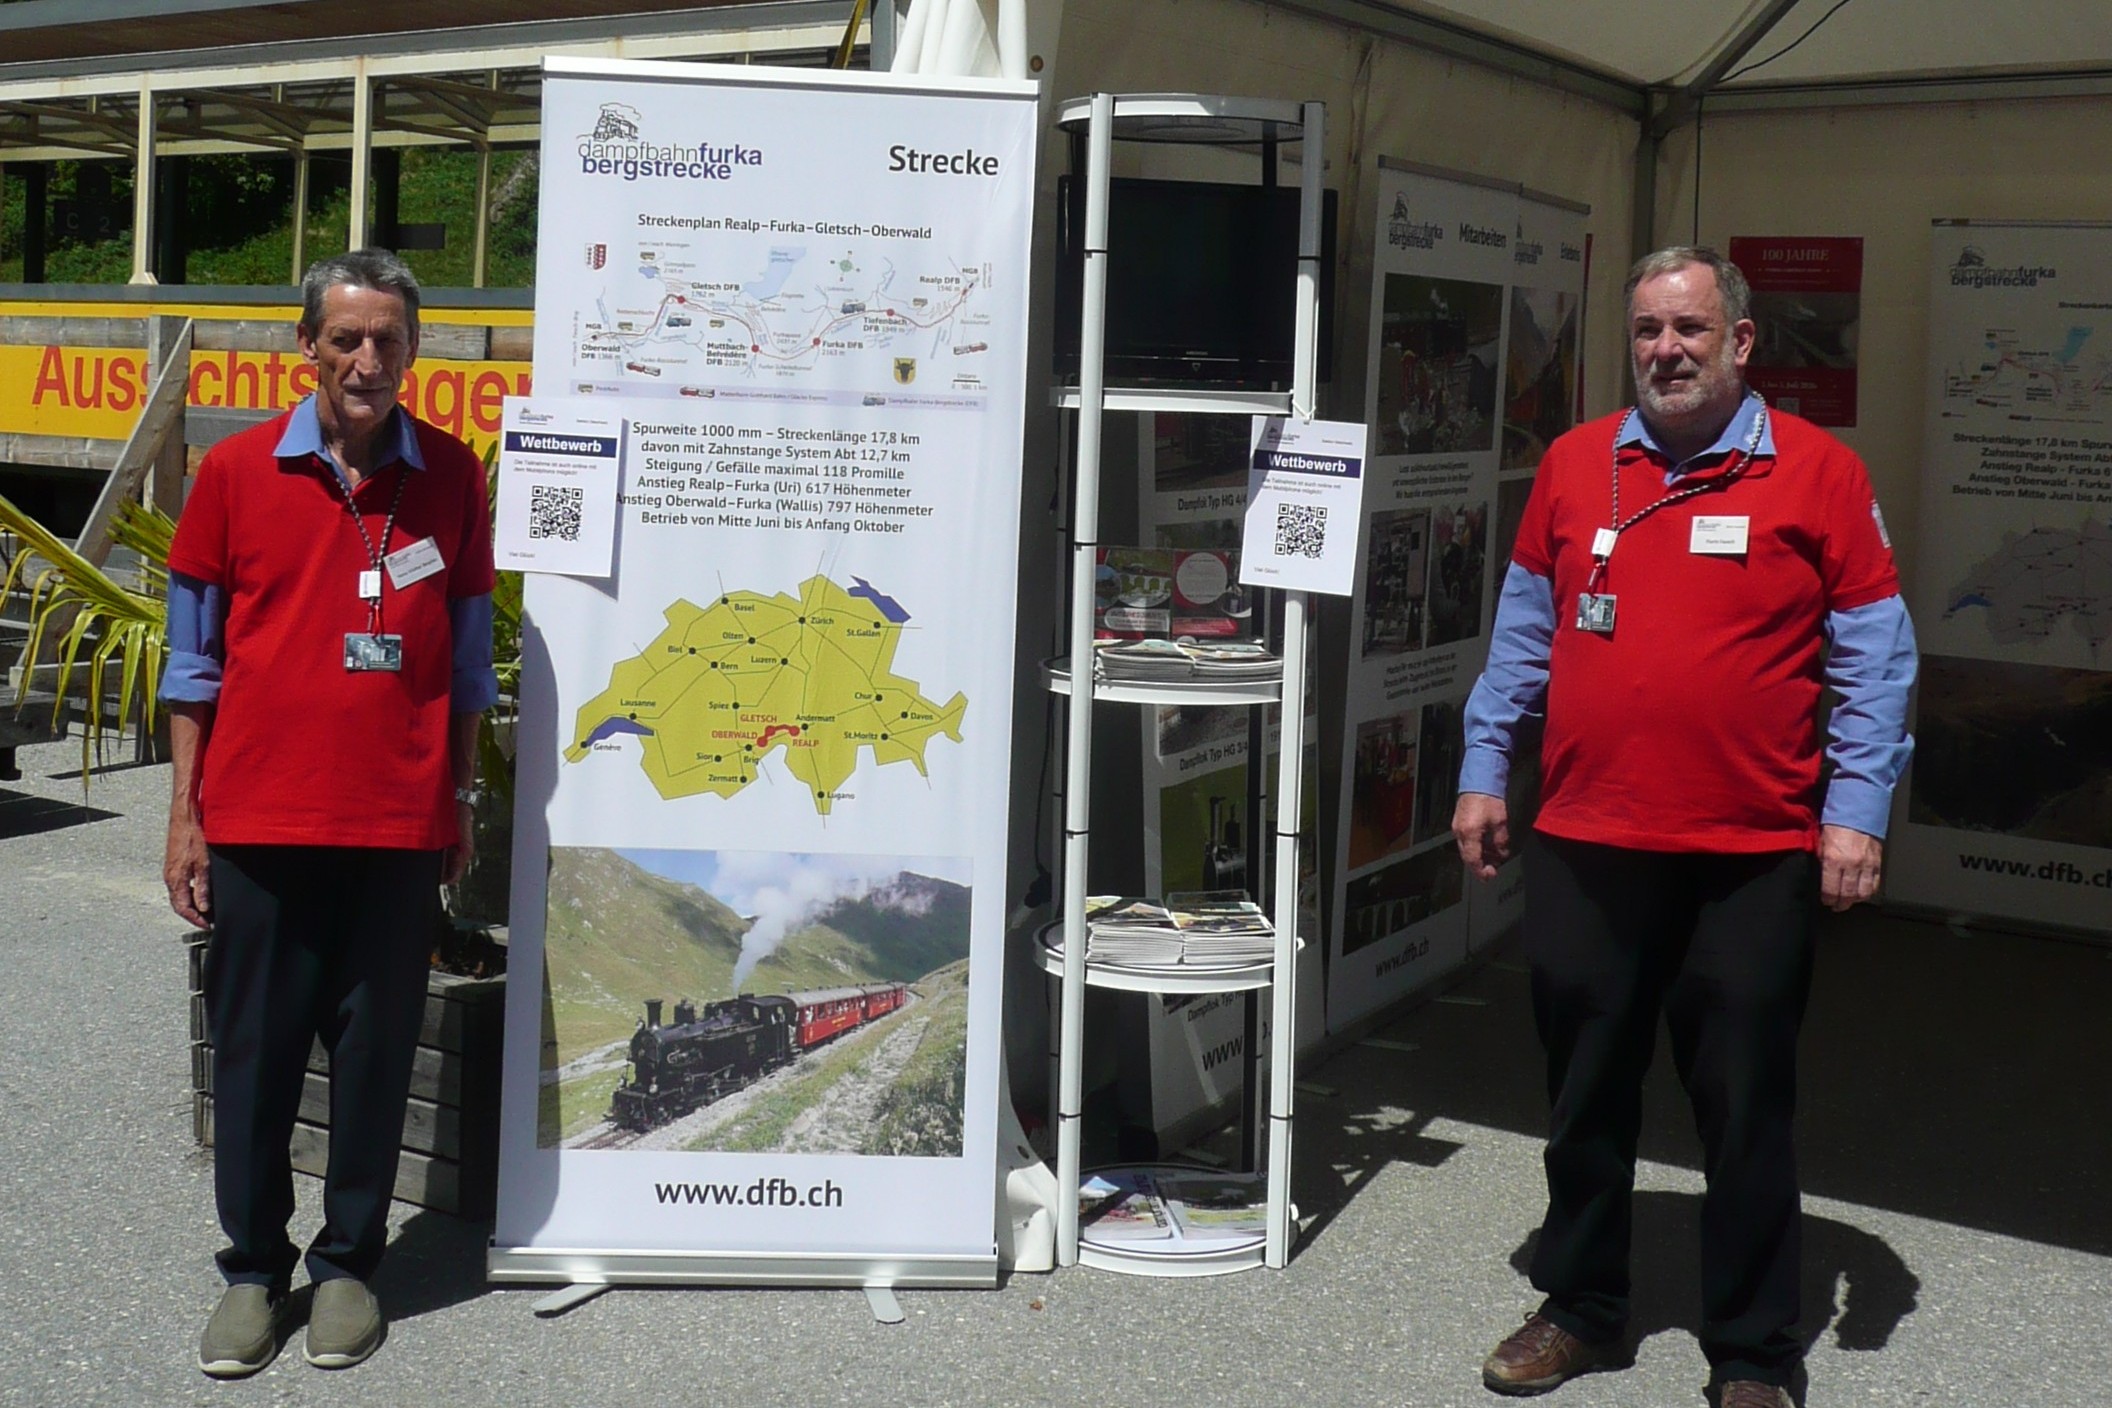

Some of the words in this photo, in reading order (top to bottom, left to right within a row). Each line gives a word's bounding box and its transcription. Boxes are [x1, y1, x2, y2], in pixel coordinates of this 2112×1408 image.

[577, 139, 762, 165] dampfbahnfurka
[888, 144, 999, 176] Strecke
[582, 156, 731, 181] bergstrecke
[98, 215, 111, 233] 2
[638, 214, 720, 230] Streckenplan
[1459, 221, 1507, 248] Mitarbeiten
[1762, 249, 1784, 261] 100
[1785, 249, 1830, 262] JAHRE
[691, 281, 721, 290] Gletsch
[723, 283, 740, 291] DFB
[919, 276, 943, 284] Realp
[944, 276, 961, 284] DFB
[1951, 275, 2037, 289] bergstrecke
[864, 317, 907, 326] Tiefenbach
[582, 344, 621, 352] Oberwald
[822, 341, 845, 349] Furka
[847, 341, 863, 349] DFB
[632, 421, 697, 436] Spurweite
[701, 424, 735, 437] 1000
[738, 427, 762, 439] mm
[777, 427, 867, 445] Streckenlänge
[871, 431, 897, 446] 17,8
[901, 433, 920, 445] km
[1952, 432, 2032, 447] Streckenlänge
[2035, 437, 2058, 448] 17,8
[2060, 438, 2078, 448] km
[520, 435, 602, 453] Wettbewerb
[641, 440, 680, 453] davon
[683, 443, 704, 454] mit
[708, 443, 782, 460] Zahnstange
[785, 445, 831, 460] System
[834, 448, 857, 460] Abt
[861, 449, 887, 463] 12,7
[891, 450, 910, 462] km
[1980, 447, 2047, 461] Zahnstange
[2049, 451, 2092, 462] System
[645, 458, 702, 473] Steigung
[705, 460, 713, 473] /
[716, 460, 761, 474] Gefälle
[764, 464, 819, 477] maximal
[823, 466, 848, 477] 118
[851, 466, 905, 480] Promille
[1268, 453, 1346, 473] Wettbewerb
[1980, 460, 2023, 473] Anstieg
[2025, 462, 2057, 475] Realp
[2068, 465, 2101, 476] Furka
[637, 476, 685, 492] Anstieg
[773, 481, 801, 496] (Uri)
[805, 482, 830, 495] 617
[833, 483, 911, 497] Höhenmeter
[1968, 472, 2011, 486] Anstieg
[2013, 475, 2068, 488] Oberwald
[2078, 479, 2111, 490] Furka
[1952, 484, 1992, 496] Betrieb
[1995, 488, 2016, 497] von
[2017, 488, 2046, 500] Mitte
[2048, 490, 2073, 501] Juni
[2076, 492, 2093, 502] bis
[616, 492, 661, 508] Anstieg
[775, 499, 823, 515] (Wallis)
[827, 500, 852, 513] 797
[855, 502, 934, 516] Höhenmeter
[1208, 495, 1220, 510] Typ
[1222, 494, 1234, 507] HG
[642, 511, 688, 525] Betrieb
[691, 515, 714, 526] von
[718, 515, 751, 527] Mitte
[754, 516, 780, 528] Juni
[784, 518, 802, 529] bis
[805, 518, 850, 534] Anfang
[853, 519, 905, 533] Oktober
[734, 603, 755, 612] Basel
[810, 616, 835, 625] Zürich
[722, 632, 744, 640] Olten
[667, 645, 683, 653] Biel
[720, 662, 739, 670] Bern
[750, 655, 777, 664] Luzern
[854, 691, 872, 700] Chur
[620, 699, 656, 707] Lausanne
[708, 701, 729, 710] Spiez
[740, 714, 777, 723] GLETSCH
[795, 714, 835, 723] Andermatt
[910, 712, 934, 721] Davos
[711, 730, 758, 739] OBERWALD
[792, 739, 820, 747] REALP
[696, 752, 713, 762] Sion
[1209, 748, 1222, 762] Typ
[1223, 743, 1236, 757] HG
[743, 755, 760, 766] Brig
[708, 773, 738, 783] Zermatt
[827, 791, 855, 801] Lugano
[654, 1177, 843, 1209] www.dfb.ch
